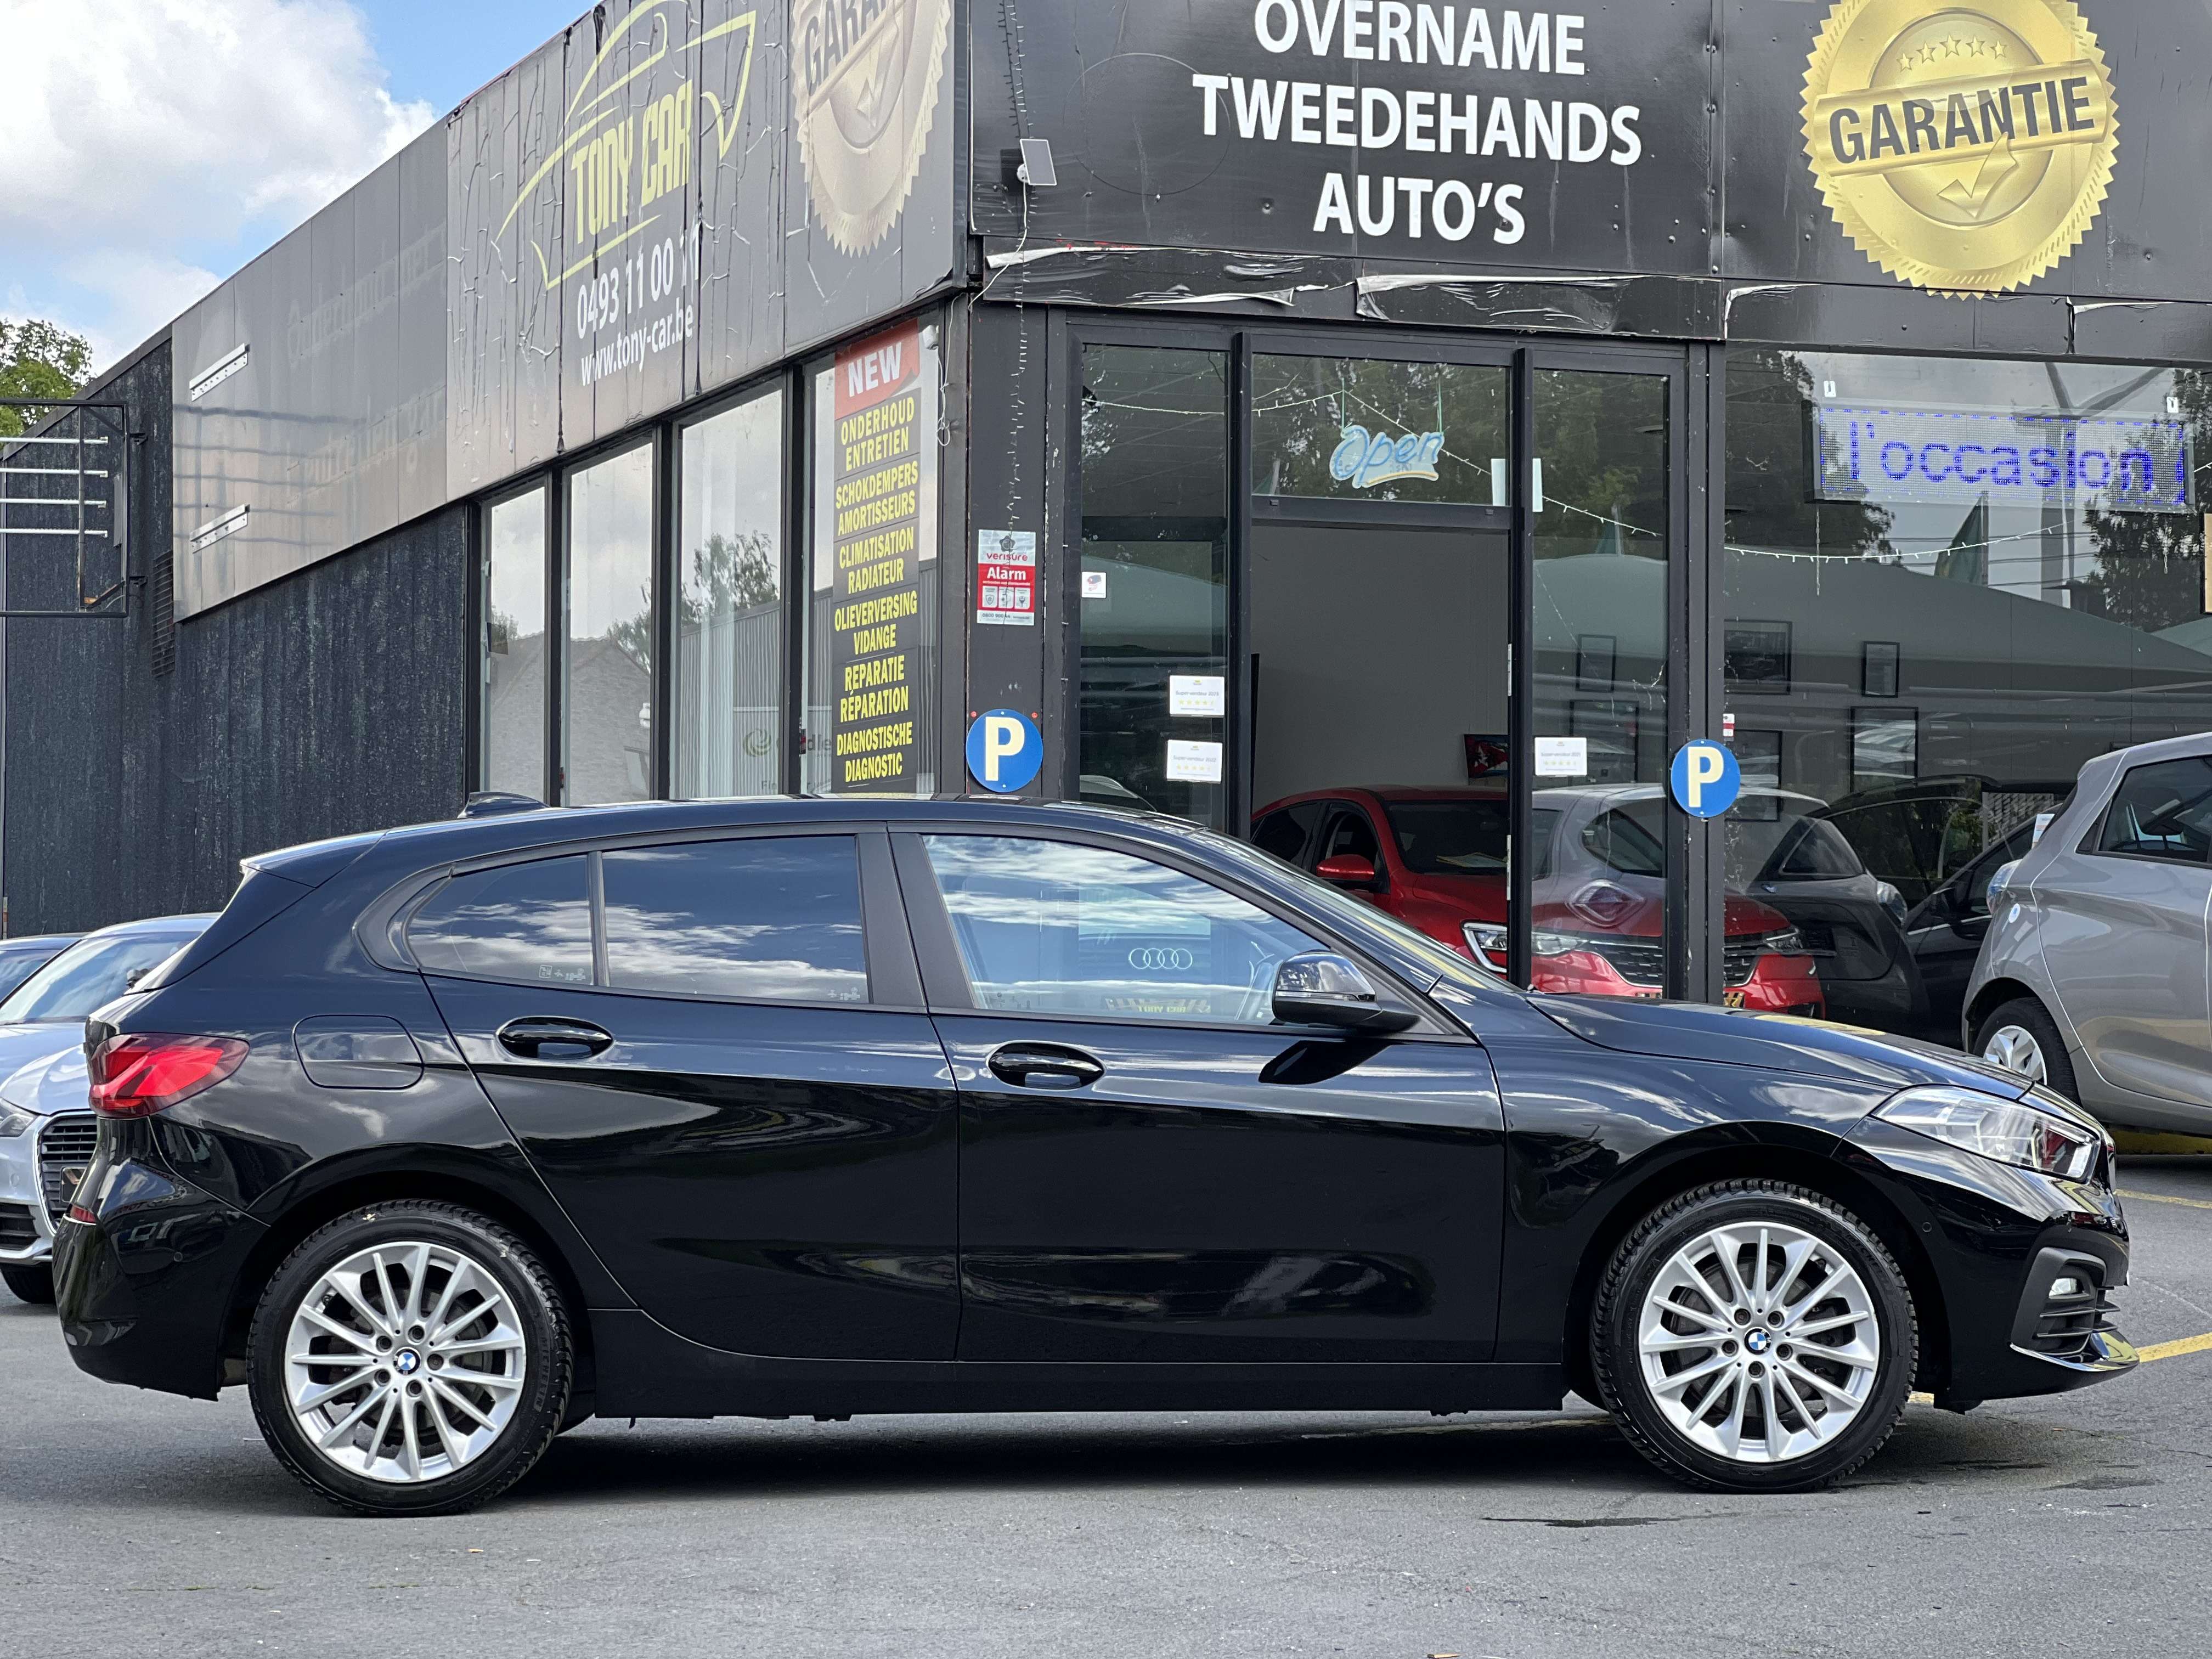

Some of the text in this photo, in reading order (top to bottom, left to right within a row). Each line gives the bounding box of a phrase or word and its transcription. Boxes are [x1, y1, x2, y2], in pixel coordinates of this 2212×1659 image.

[1254, 0, 1585, 75] OVERNAME
[1192, 73, 1642, 166] TWEEDEHANDS
[1829, 76, 2095, 165] GARANTIE
[571, 78, 692, 245] TONY CAR
[1312, 172, 1525, 245] AUTO'S
[577, 267, 619, 339] 0493
[625, 253, 644, 314] 11
[651, 237, 674, 302] 00
[580, 297, 693, 387] www.tony-car.be
[848, 342, 902, 398] NEW
[840, 396, 915, 446] ONDERHOUD
[845, 426, 910, 472] ENTRETIEN
[1329, 425, 1445, 489] Open
[1848, 420, 2156, 494] l'occasion
[836, 460, 919, 510] SCHOKDEMPERS
[838, 490, 916, 537] AMORTISSEURS
[839, 526, 915, 569] CLIMATISATION
[986, 552, 1028, 561] verisure
[848, 558, 904, 594] RADIATEUR
[987, 566, 1026, 581] Alarm
[834, 590, 918, 632] OLIEVERVERSING
[854, 624, 896, 655] VIDANGE
[845, 655, 905, 691] REPARATIE
[840, 686, 909, 723] RÉPARATION
[837, 721, 913, 756] DIAGNOSTISCHE
[985, 716, 1025, 781] P
[845, 752, 903, 782] DIAGNOSTIC
[1687, 746, 1724, 808] P
